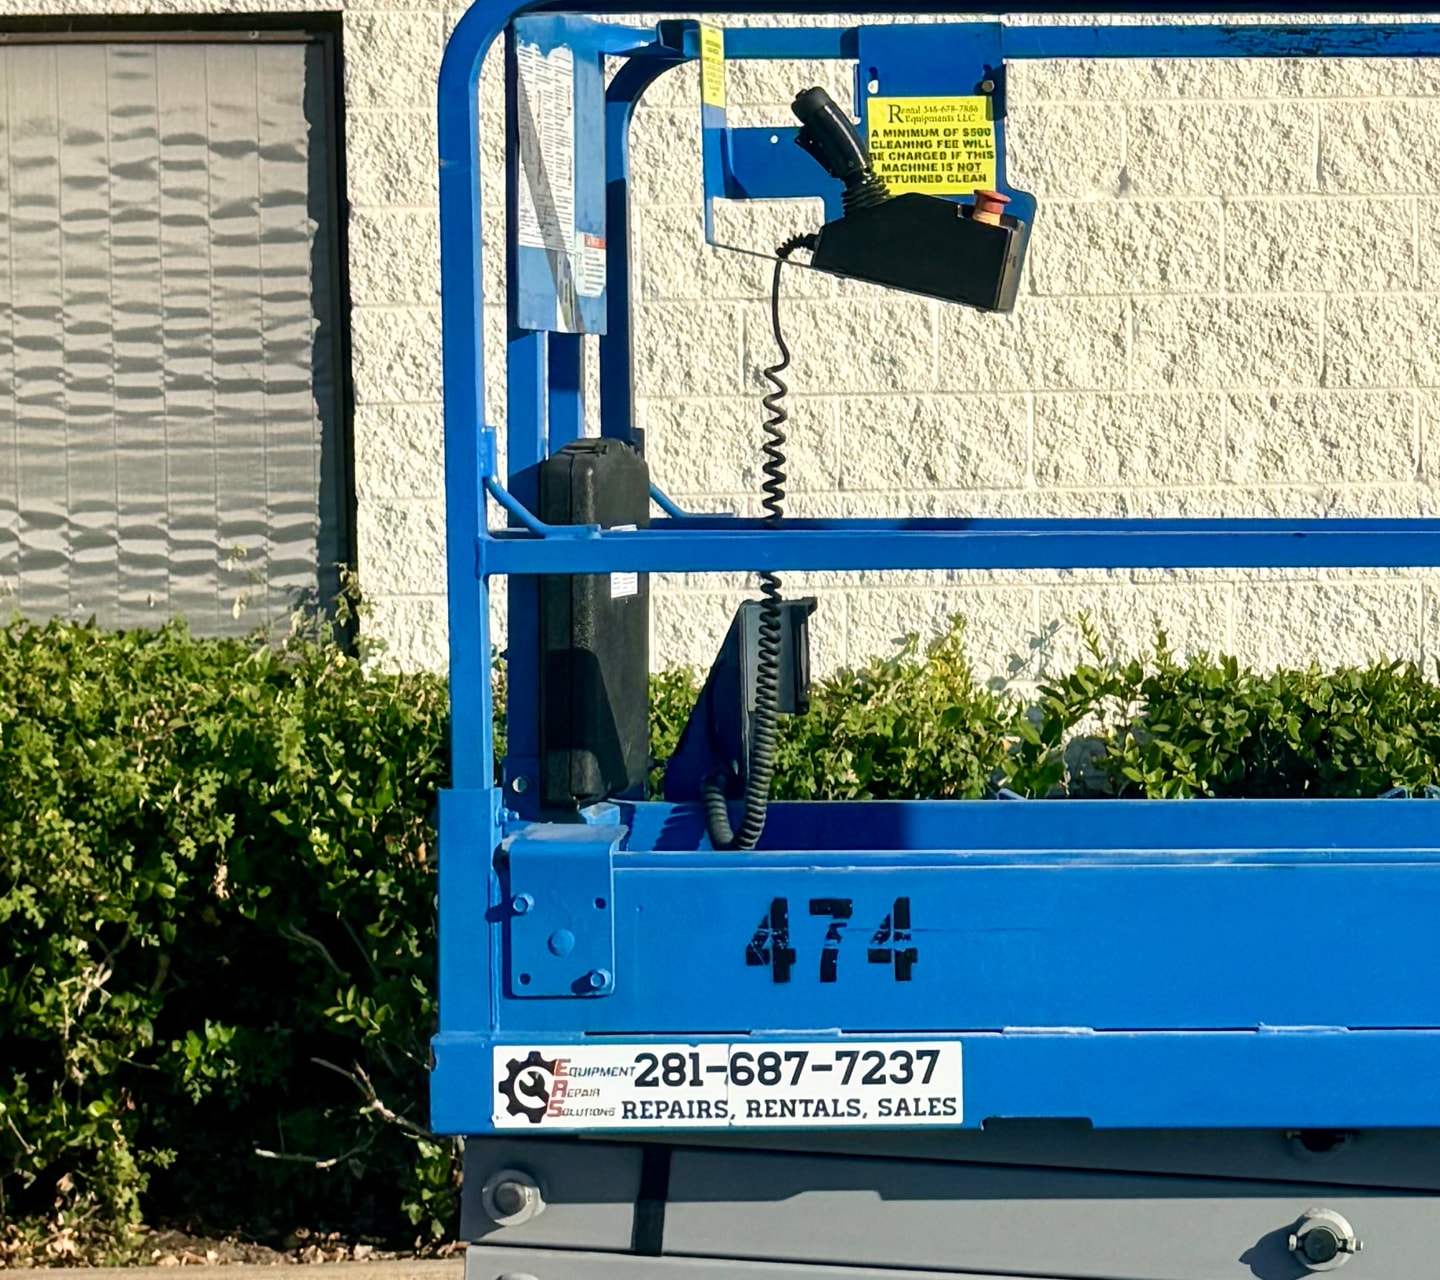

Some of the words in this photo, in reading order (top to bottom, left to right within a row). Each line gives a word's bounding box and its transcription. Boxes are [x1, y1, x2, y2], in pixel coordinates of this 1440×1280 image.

[957, 114, 976, 122] LLC
[871, 129, 880, 138] A
[882, 128, 940, 138] MINIMUM
[943, 128, 959, 137] OF
[962, 127, 992, 137] $500
[871, 140, 933, 149] CLEANING
[937, 139, 959, 149] FEE
[962, 139, 993, 148] WILL
[888, 151, 947, 161] CHARGED
[951, 151, 962, 160] IF
[965, 151, 994, 160] THIS
[881, 163, 938, 172] MACHINE
[941, 163, 953, 172] IS
[957, 162, 982, 172] NOT
[947, 174, 987, 183] CLEAN
[746, 896, 918, 983] 474
[553, 1058, 637, 1078] EQUIPMENT
[634, 1049, 941, 1088] 281-687-7237
[551, 1080, 601, 1098] REPAIR
[547, 1099, 617, 1118] SOLUTIONS
[621, 1099, 736, 1120] REPAIRS,
[746, 1098, 868, 1119] RENTALS,
[878, 1097, 957, 1118] SALES
